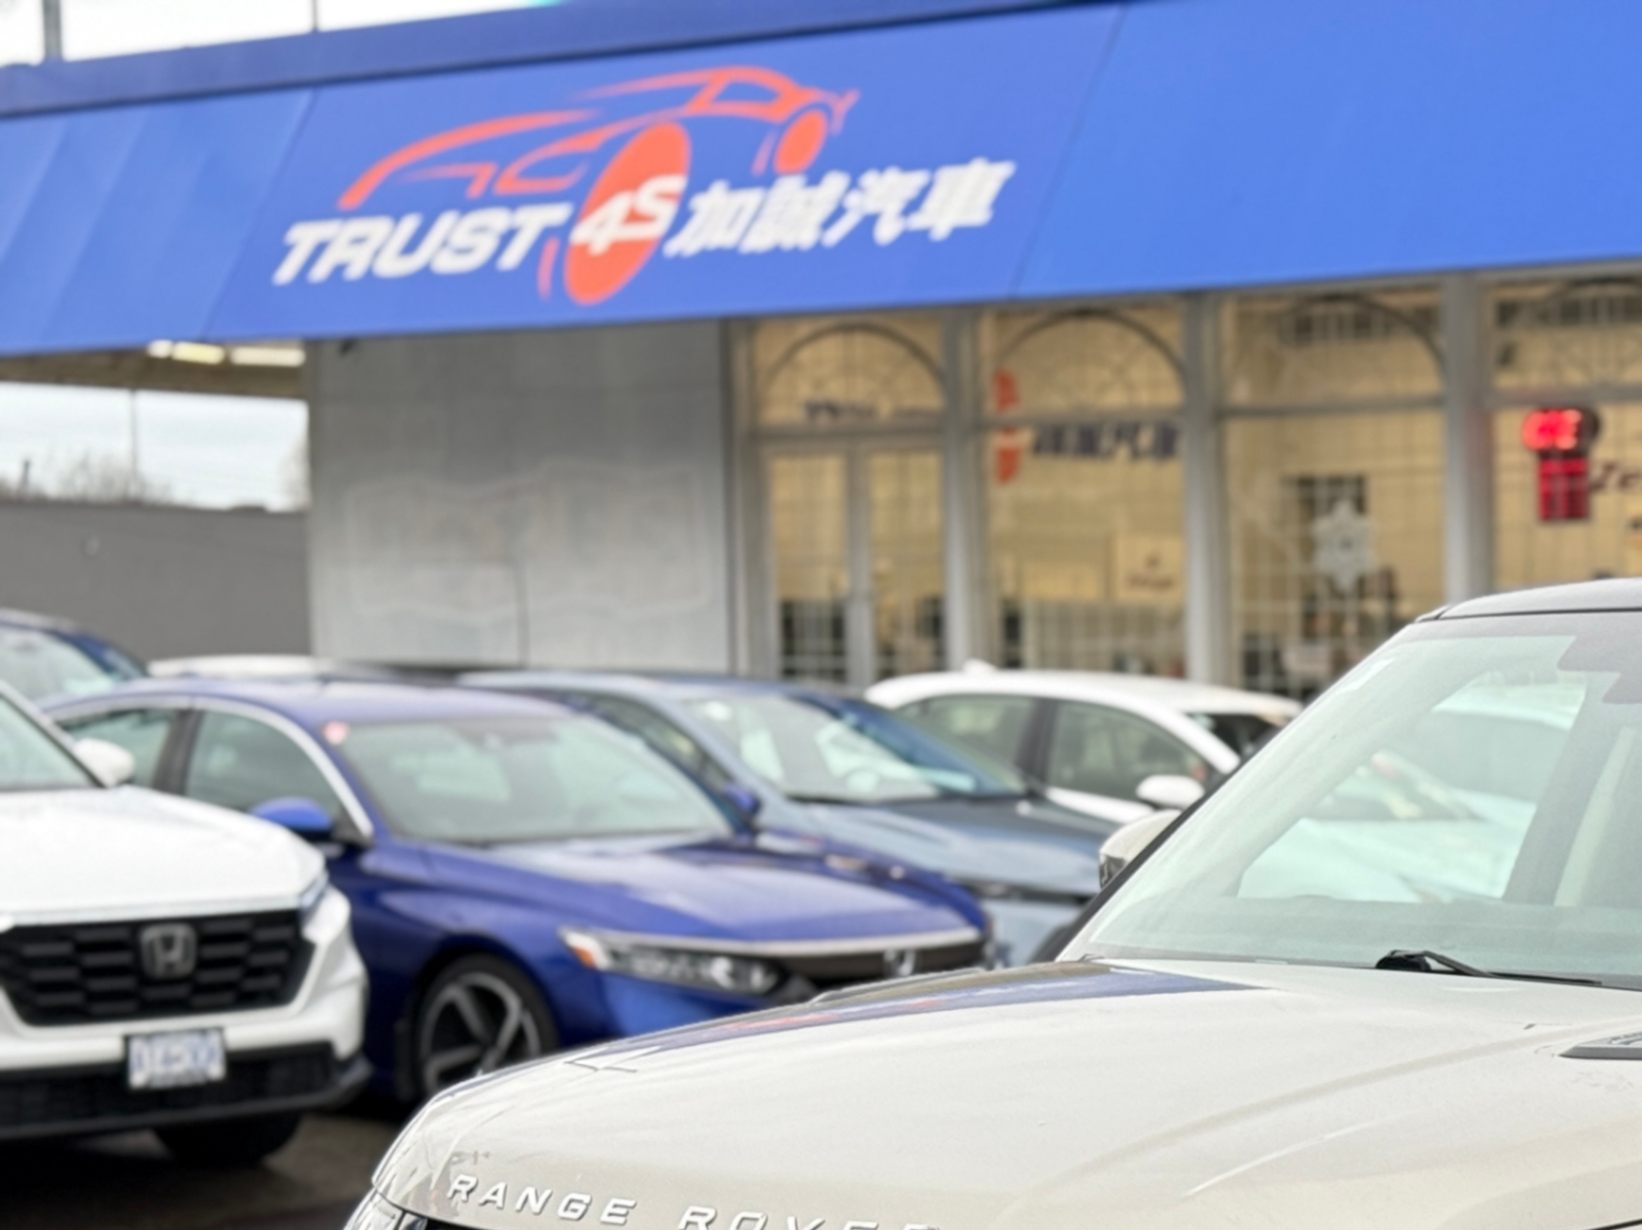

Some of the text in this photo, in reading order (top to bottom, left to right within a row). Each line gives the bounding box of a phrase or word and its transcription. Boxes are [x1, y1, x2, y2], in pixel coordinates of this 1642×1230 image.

[272, 202, 573, 285] TRUST
[567, 174, 688, 256] 4S
[446, 1173, 637, 1226] RANGE
